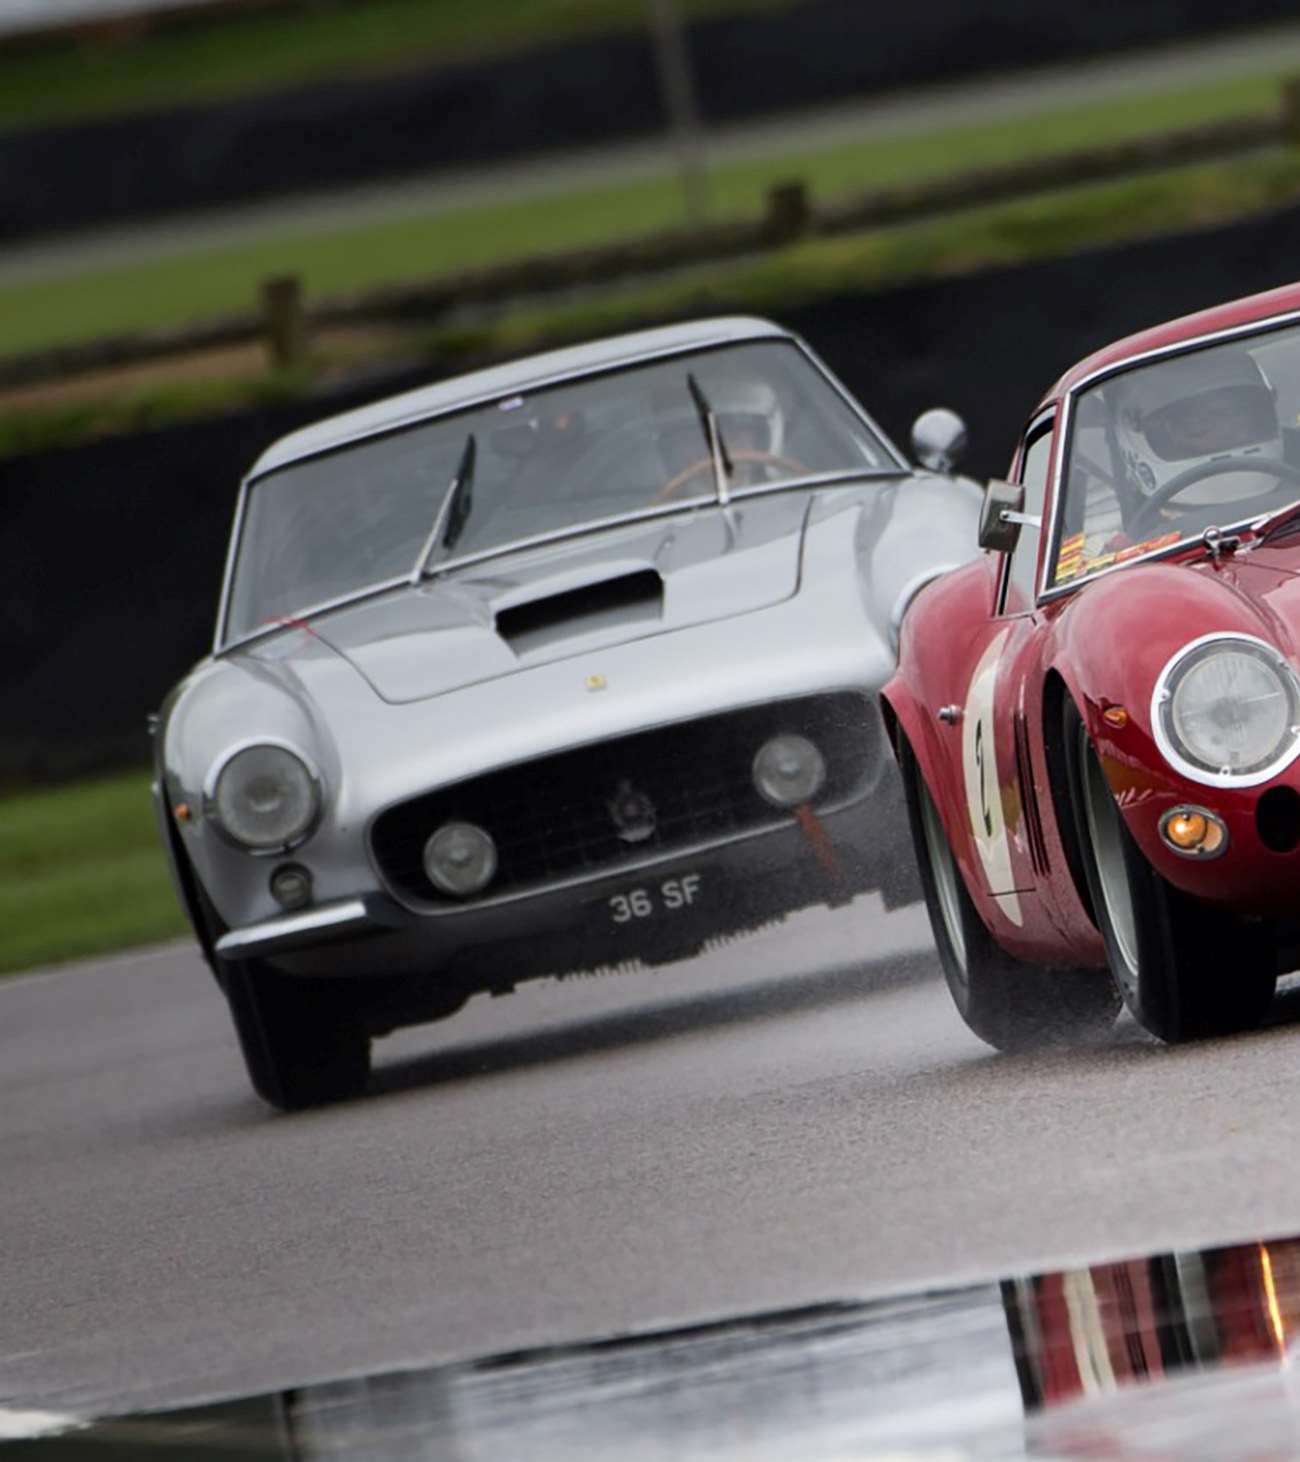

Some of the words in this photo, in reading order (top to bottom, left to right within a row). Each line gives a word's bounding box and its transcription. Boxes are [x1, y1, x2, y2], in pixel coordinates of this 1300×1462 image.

[975, 719, 993, 837] 2
[609, 888, 652, 923] 36
[661, 875, 700, 909] SF
